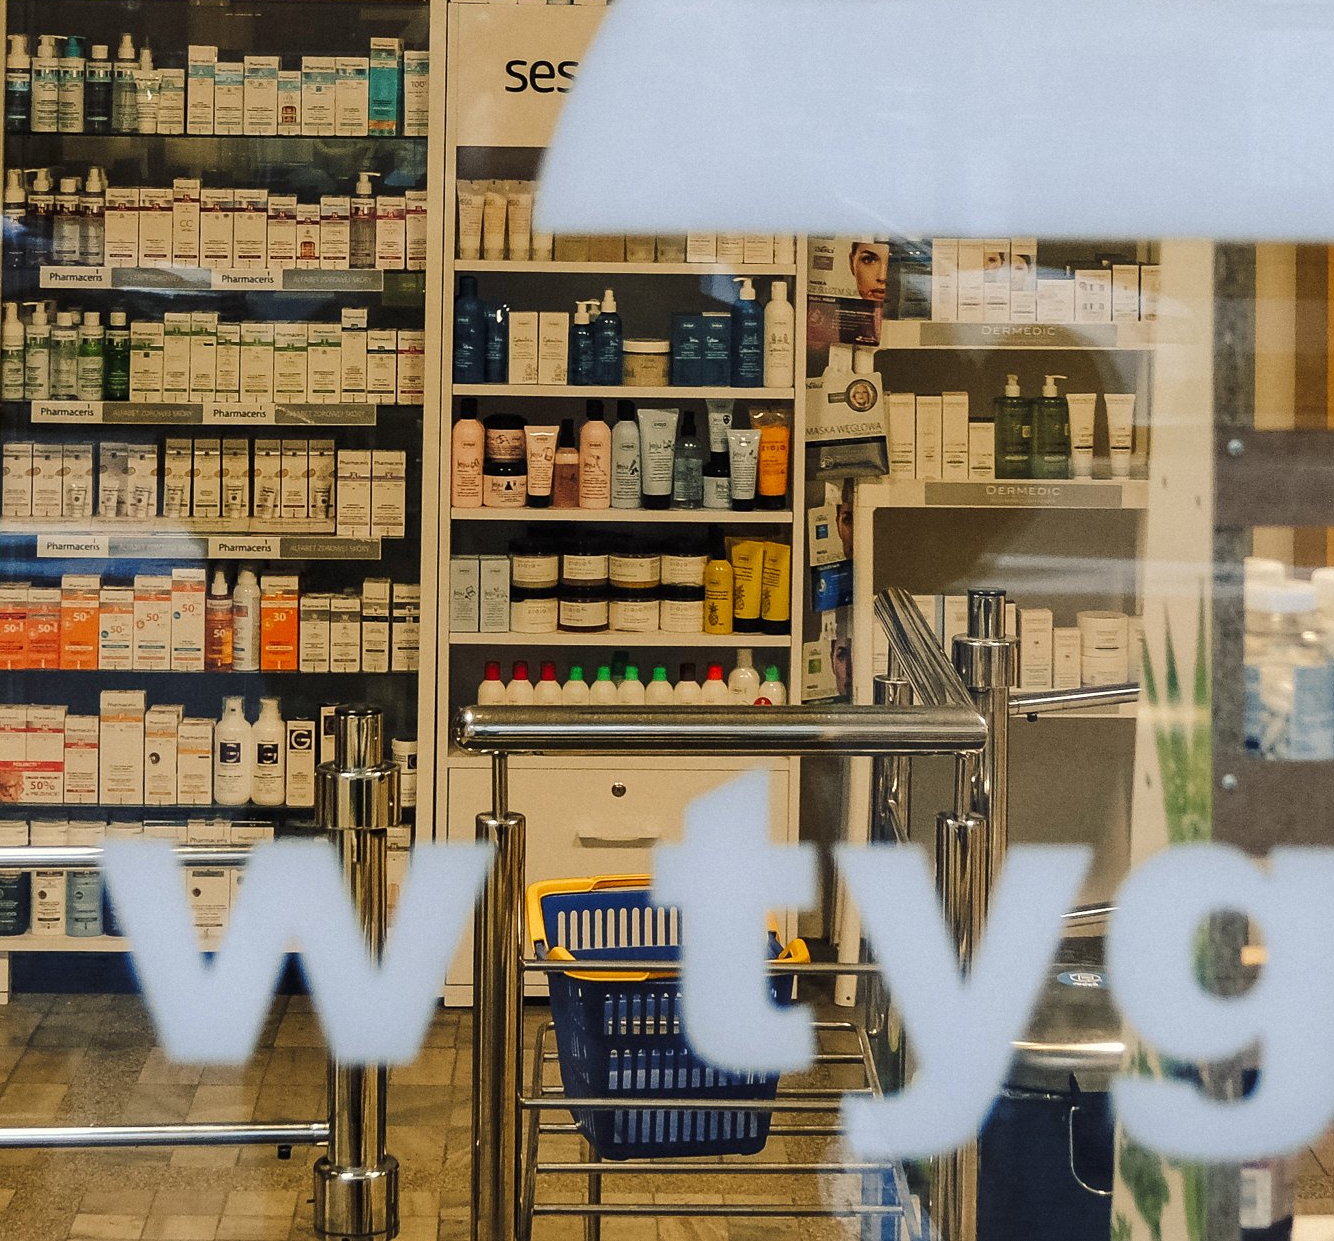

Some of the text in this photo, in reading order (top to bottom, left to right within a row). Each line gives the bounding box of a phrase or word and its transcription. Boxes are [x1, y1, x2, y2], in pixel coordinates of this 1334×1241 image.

[49, 269, 102, 282] Pharmaceris
[221, 272, 274, 284] Pharmaceris
[981, 326, 1056, 336] DERMEDIC
[40, 404, 94, 416] Pharmaceris
[213, 406, 266, 418] Pharmaceris
[985, 485, 1061, 496] DERMEDIC
[46, 538, 100, 551] Pharmaceris
[218, 540, 272, 552] Pharmaceris
[291, 730, 311, 749] G
[30, 781, 55, 790] 50%
[77, 838, 493, 1068] w
